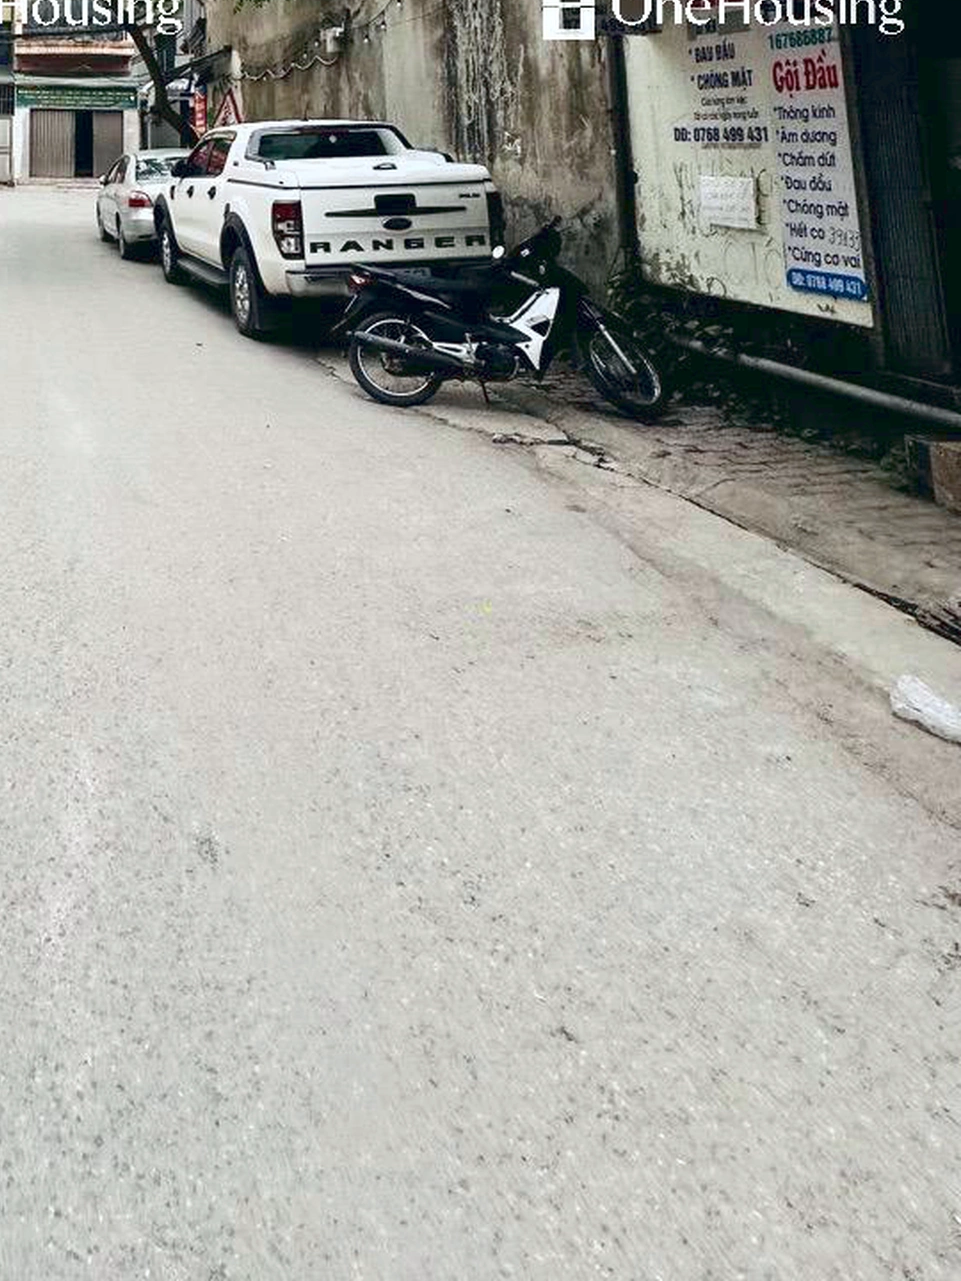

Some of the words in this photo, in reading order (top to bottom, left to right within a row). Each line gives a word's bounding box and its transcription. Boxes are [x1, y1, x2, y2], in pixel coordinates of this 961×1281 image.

[773, 58, 800, 98] Gội
[803, 49, 839, 90] Đầu
[693, 126, 719, 142] 0768
[747, 125, 768, 142] 431
[785, 176, 807, 190] Đau
[787, 199, 824, 219] Chóng
[309, 234, 486, 254] RANGER
